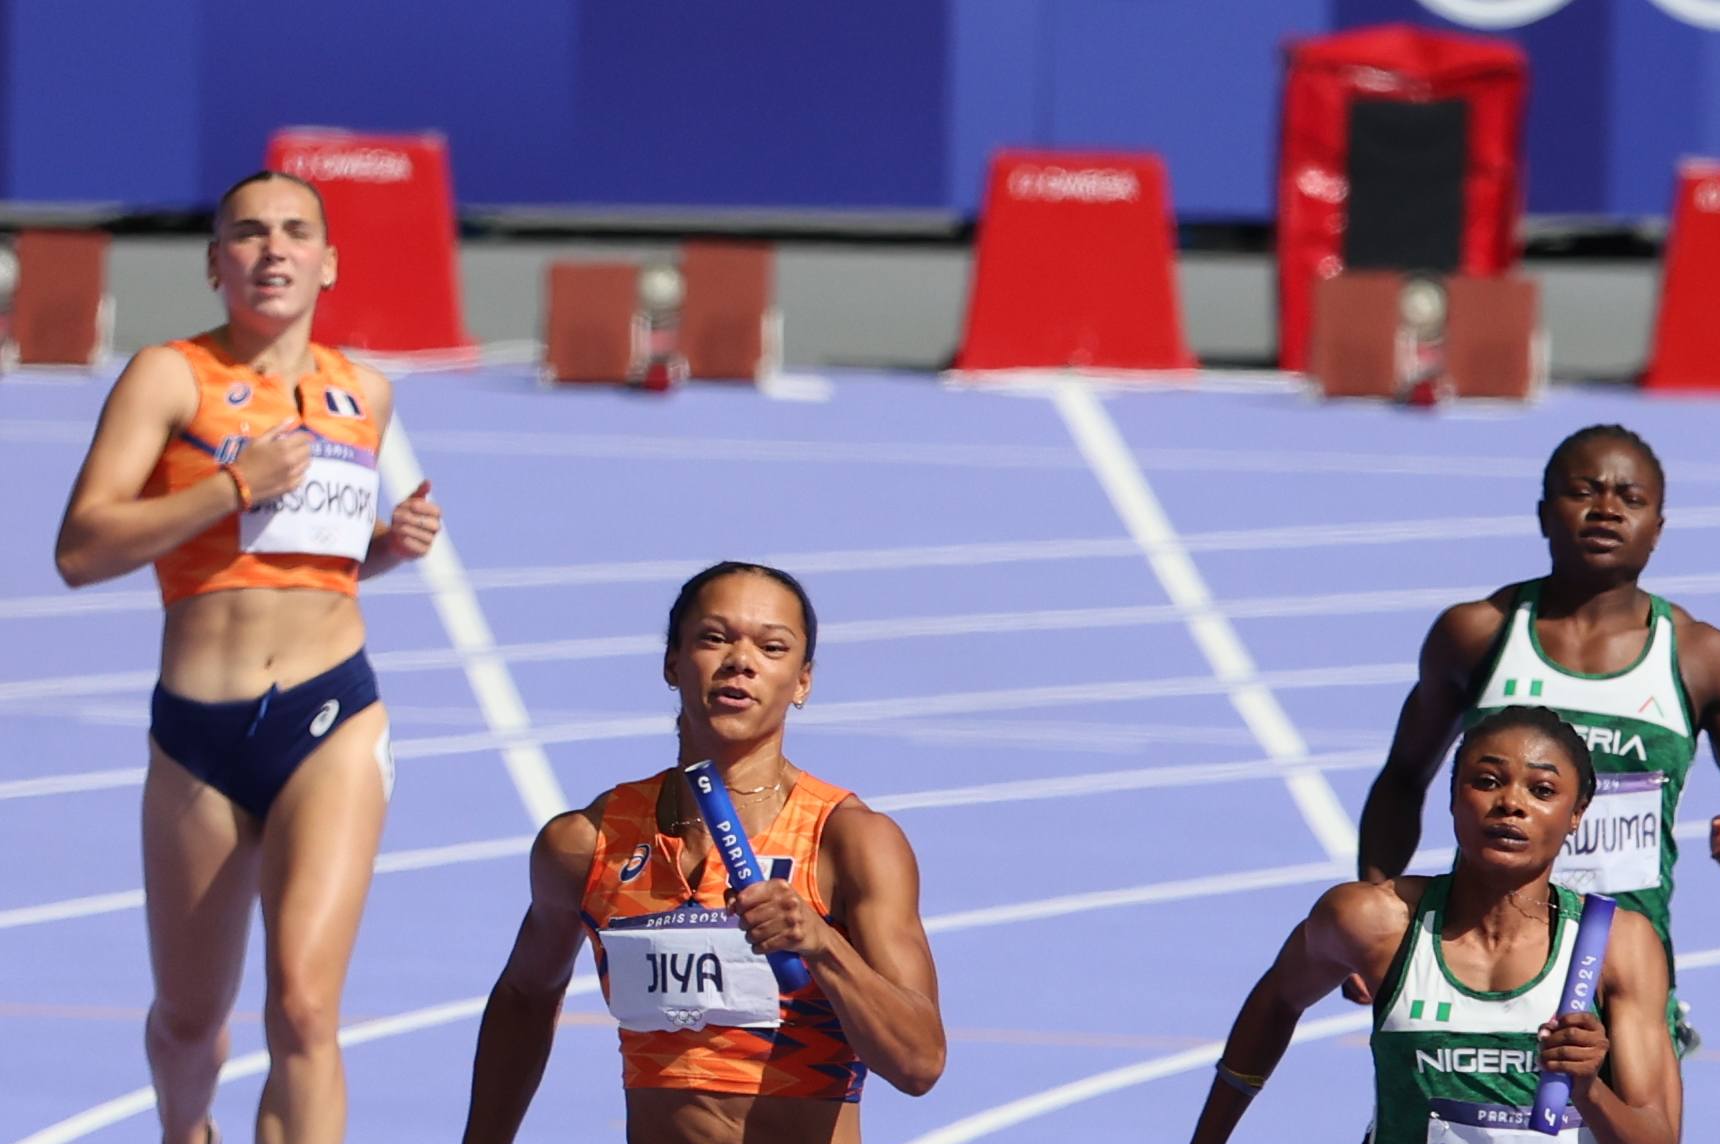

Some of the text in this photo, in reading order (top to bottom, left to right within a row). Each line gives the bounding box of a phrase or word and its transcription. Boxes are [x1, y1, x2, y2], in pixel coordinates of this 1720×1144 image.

[698, 776, 712, 794] 5
[690, 912, 728, 924] 2024
[646, 953, 724, 993] JIYA
[1570, 955, 1597, 1011] 2024
[1415, 1048, 1541, 1074] NIGERI
[1544, 1108, 1556, 1127] 4
